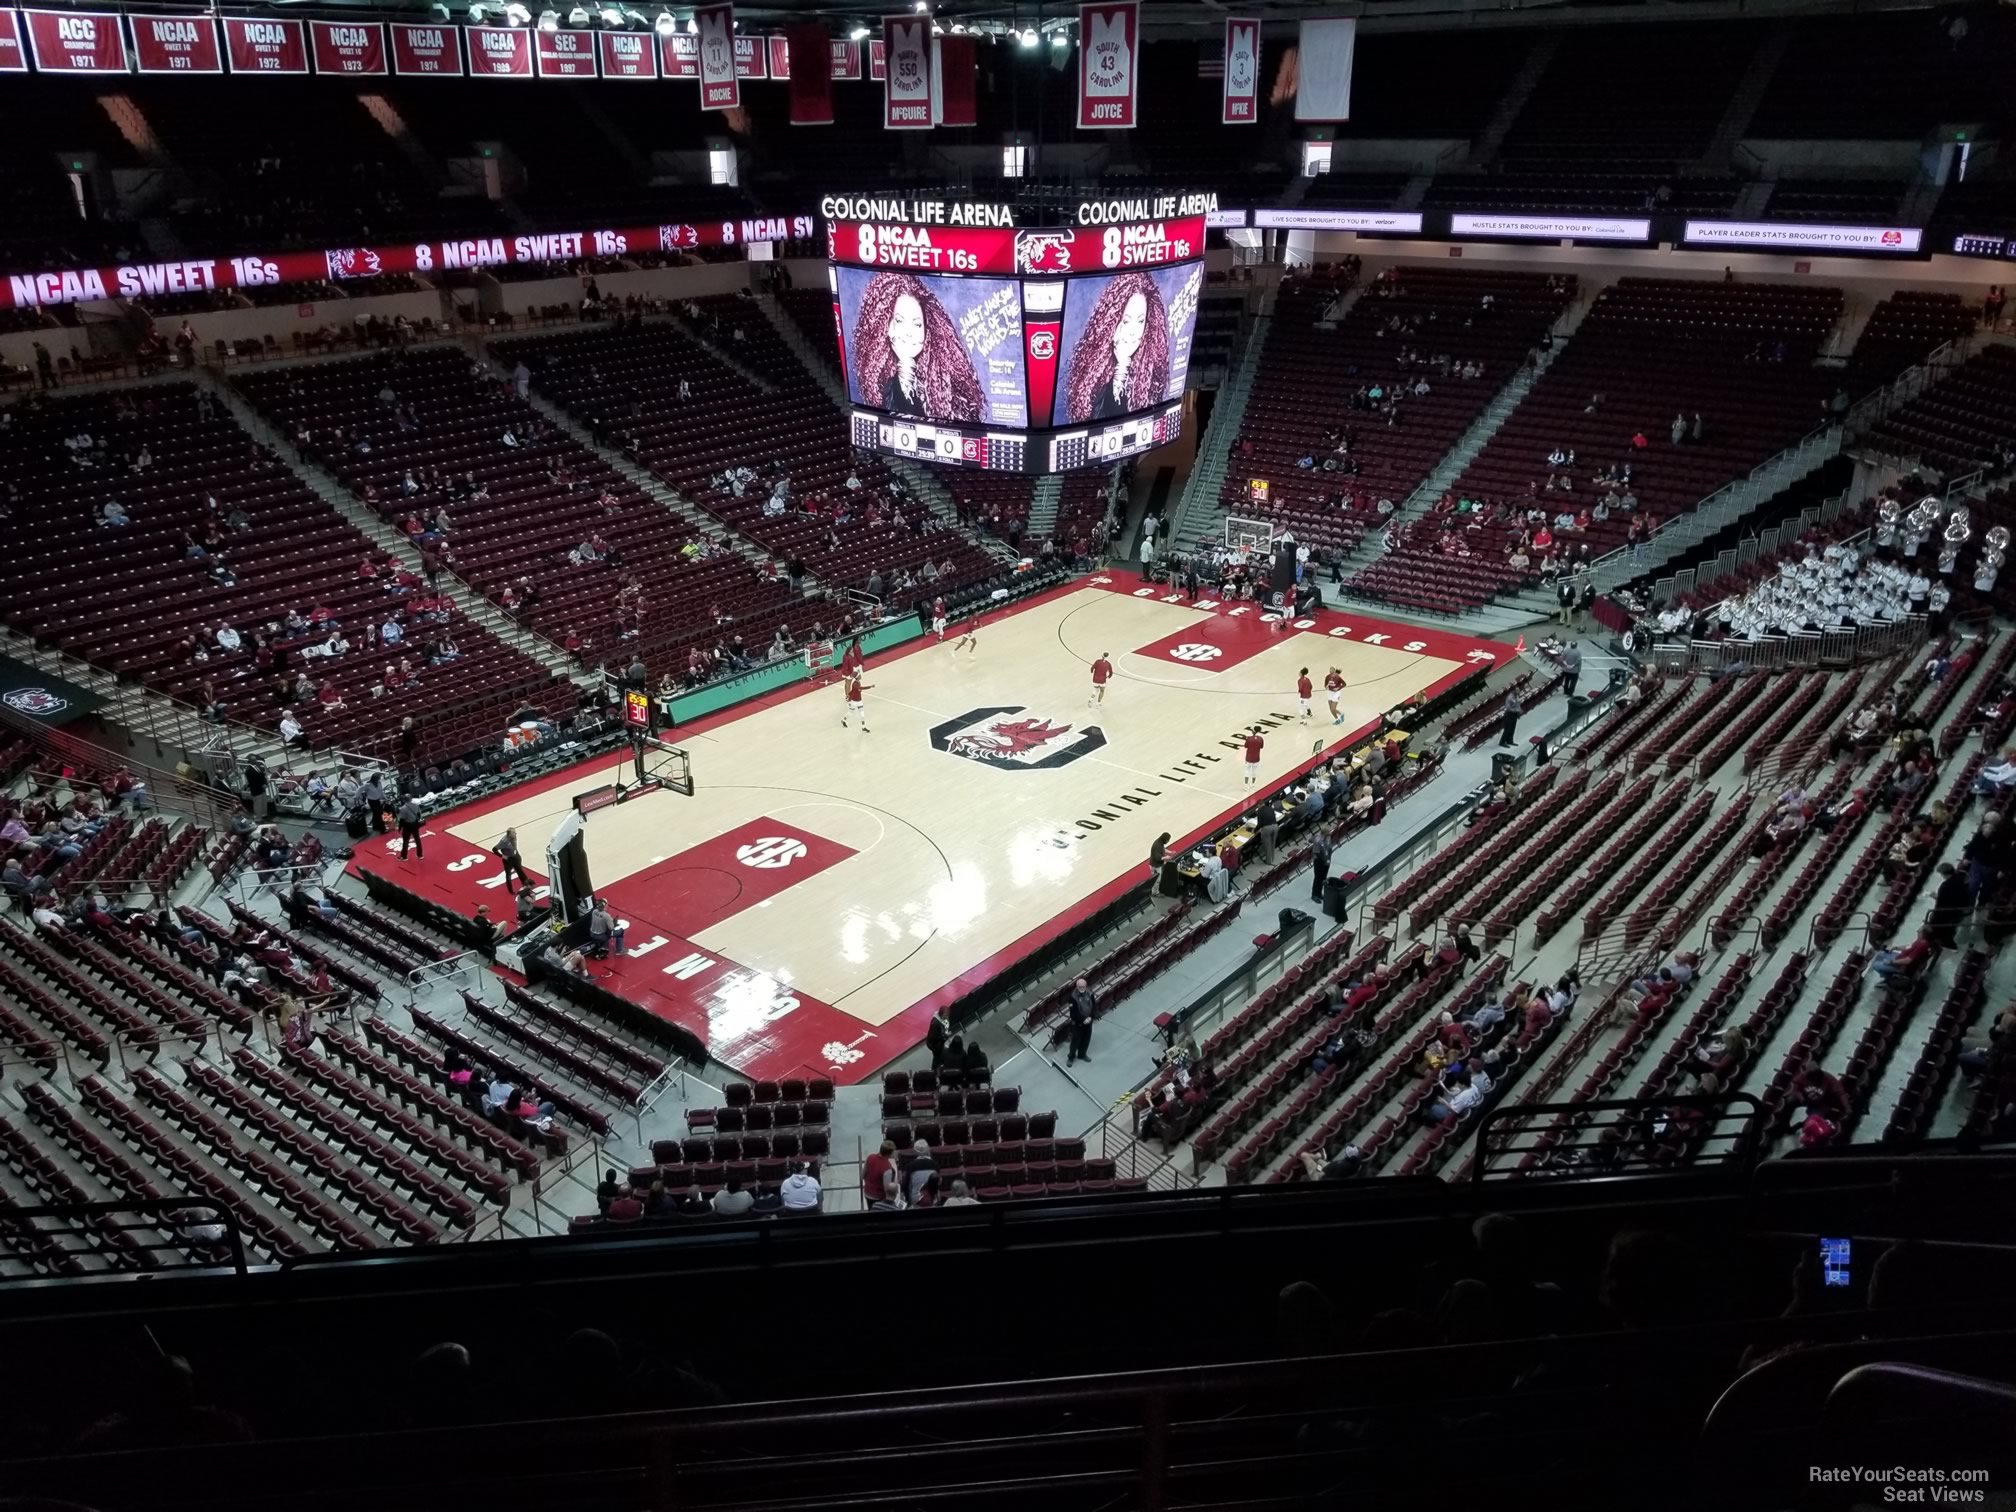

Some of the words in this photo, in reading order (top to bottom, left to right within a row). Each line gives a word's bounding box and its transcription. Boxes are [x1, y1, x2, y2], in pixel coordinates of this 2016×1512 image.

[58, 18, 95, 40] ACC
[152, 21, 199, 42] NCAA
[244, 23, 286, 44] NCAA
[329, 27, 368, 47] NCAA
[407, 29, 444, 48] NCAA
[481, 32, 516, 51] NCAA
[554, 34, 577, 51] SEC
[612, 36, 642, 54] NCAA
[712, 48, 721, 61] 11
[833, 43, 846, 58] NIT
[1096, 41, 1120, 56] SOUTH
[70, 55, 95, 67] 1971
[168, 56, 191, 68] 1971
[258, 57, 280, 69] 1972
[342, 60, 363, 71] 1973
[420, 60, 439, 71] 1974
[560, 63, 576, 73] 1997
[706, 61, 729, 76] CAROLINA
[899, 62, 918, 76] 550
[1100, 56, 1115, 71] 43
[1239, 62, 1245, 75] 3
[622, 65, 638, 74] 1997
[894, 76, 923, 92] CAROLINA
[1089, 70, 1125, 88] CAROLINA
[1231, 75, 1252, 89] CAROLINA
[709, 87, 732, 102] ROCHE
[1091, 103, 1123, 119] JOYCE
[821, 197, 909, 222] COLONIAL
[913, 201, 945, 224] LIFE
[950, 202, 1014, 227] ARENA
[1078, 198, 1150, 225] COLONIAL
[1153, 196, 1176, 218] LIFE
[1177, 192, 1218, 216] ARENA
[722, 222, 735, 245] 8
[742, 217, 787, 243] NCAA
[878, 226, 931, 247] NCAA
[1123, 223, 1166, 245] NCAA
[1698, 229, 1729, 237] PLAYER
[1730, 230, 1761, 238] LEADER
[1762, 231, 1787, 239] STATS
[1788, 232, 1828, 240] BROUGHT
[415, 243, 433, 272] 8
[442, 239, 508, 269] NCAA
[514, 232, 583, 263] SWEET
[592, 230, 627, 256] 16s
[858, 223, 877, 264] 8
[1102, 227, 1121, 268] 8
[879, 246, 942, 268] SWEET
[946, 249, 977, 270] 16s
[1123, 242, 1172, 265] SWEET
[1173, 240, 1190, 258] 16s
[9, 270, 107, 308] NCAA
[117, 260, 215, 298] SWEET
[230, 256, 279, 287] 16s
[900, 432, 910, 447] 0
[1141, 427, 1149, 442] 0
[943, 439, 954, 454] 0
[1108, 436, 1117, 451] 0
[1252, 487, 1265, 500] 30
[1169, 643, 1223, 662] SEC
[632, 703, 646, 722] 30
[1159, 752, 1223, 783] LIFE
[736, 836, 808, 868] SEC
